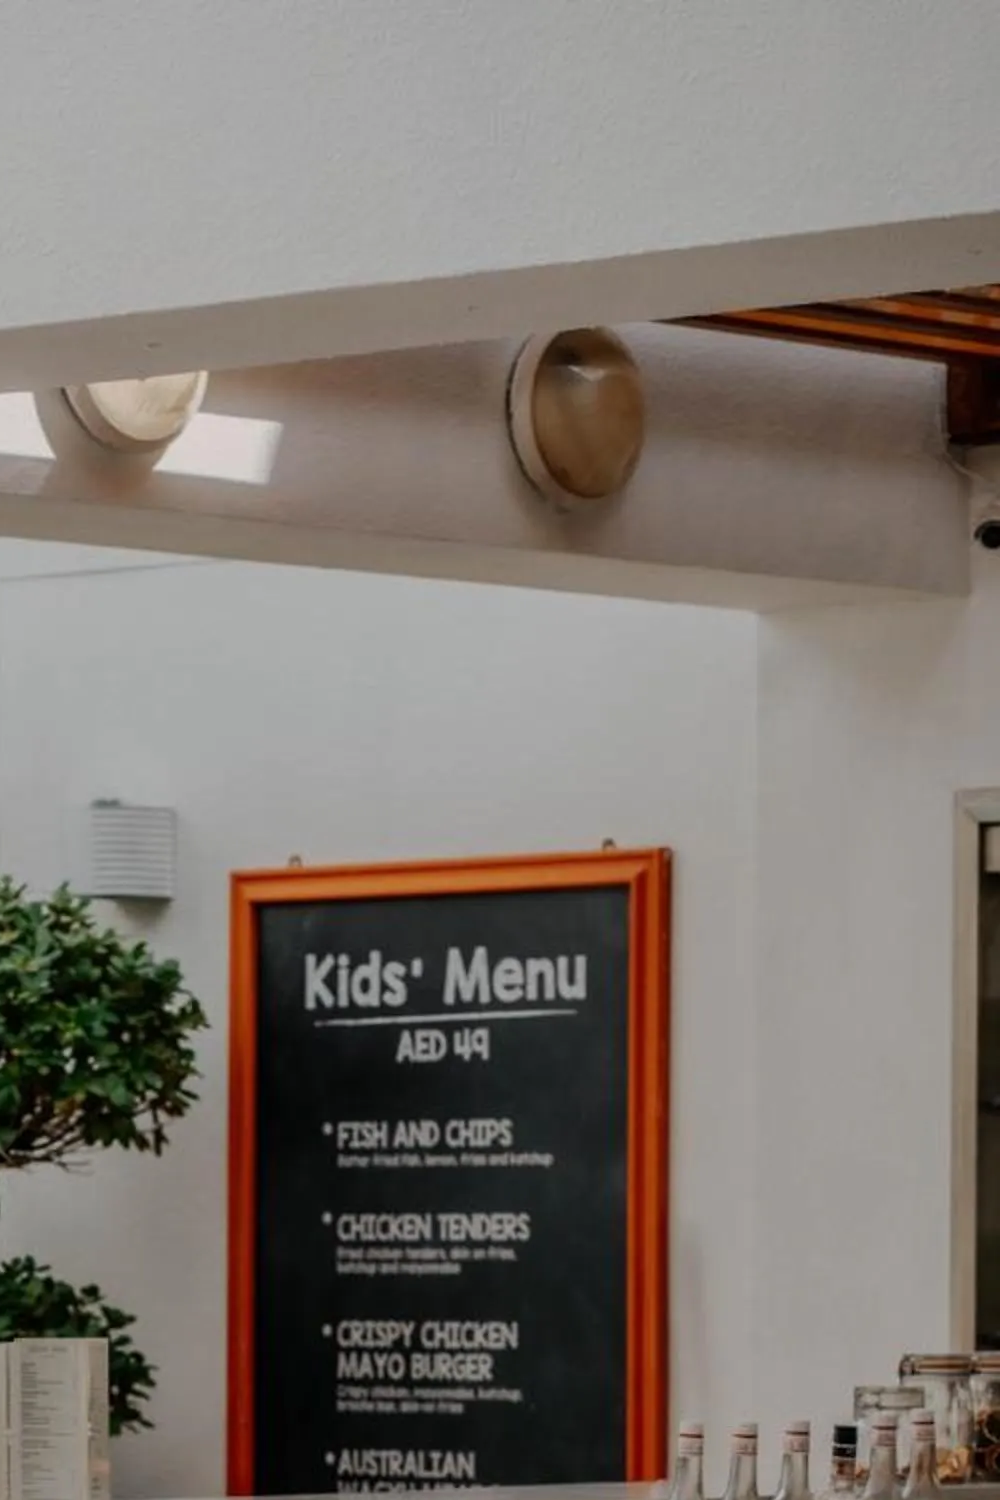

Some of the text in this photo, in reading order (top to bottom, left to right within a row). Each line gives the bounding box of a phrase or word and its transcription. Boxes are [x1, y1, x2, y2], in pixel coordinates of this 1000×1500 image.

[305, 946, 587, 1010] Kids' Menu
[395, 1027, 490, 1063] AED 49
[337, 1118, 514, 1149] FISH AND CHIPS
[337, 1213, 531, 1241] CHICKEN TENDERS
[337, 1320, 519, 1349] CRISPY CHICKEN
[337, 1353, 493, 1381] MAYO BURGER
[338, 1448, 476, 1479] AUSTRALIAN
